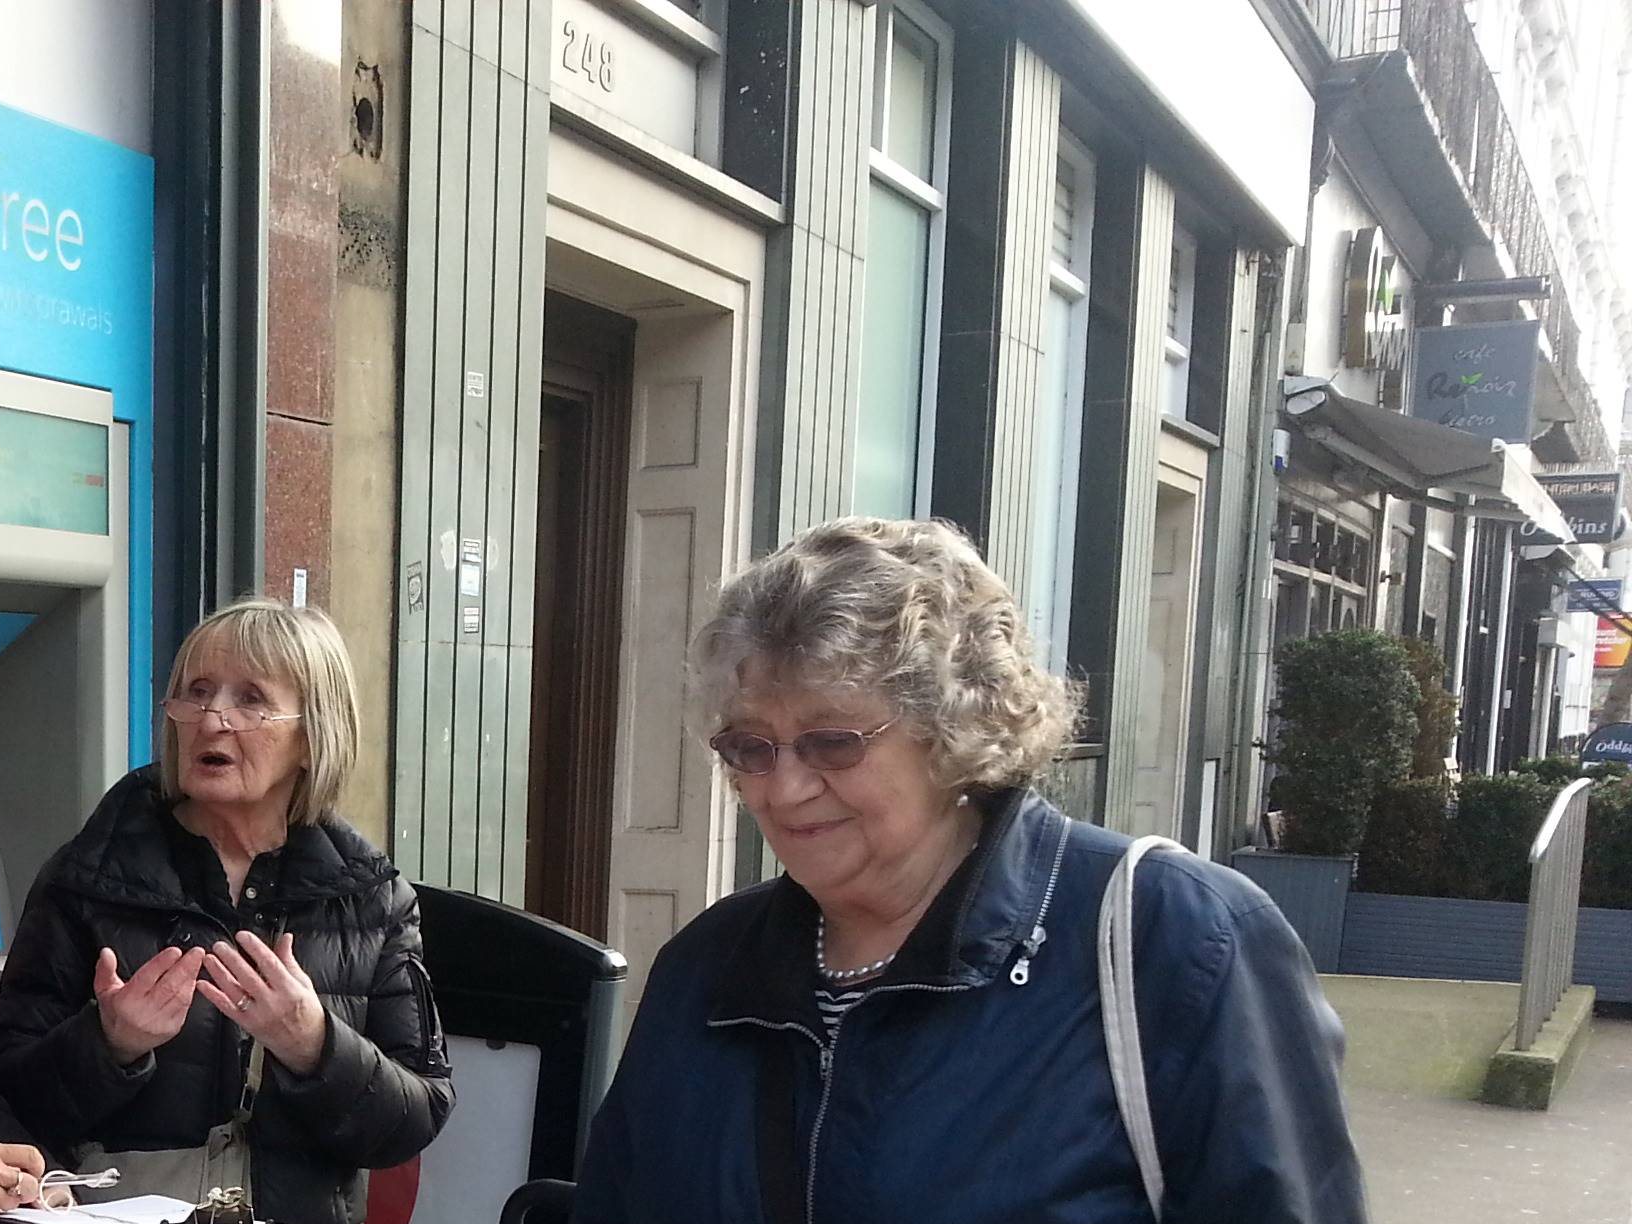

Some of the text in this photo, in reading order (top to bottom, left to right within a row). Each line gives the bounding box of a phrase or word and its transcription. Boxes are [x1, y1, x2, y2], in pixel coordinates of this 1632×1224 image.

[563, 20, 616, 92] 248
[1520, 516, 1608, 538] Obins
[1595, 740, 1632, 755] Oddbi
